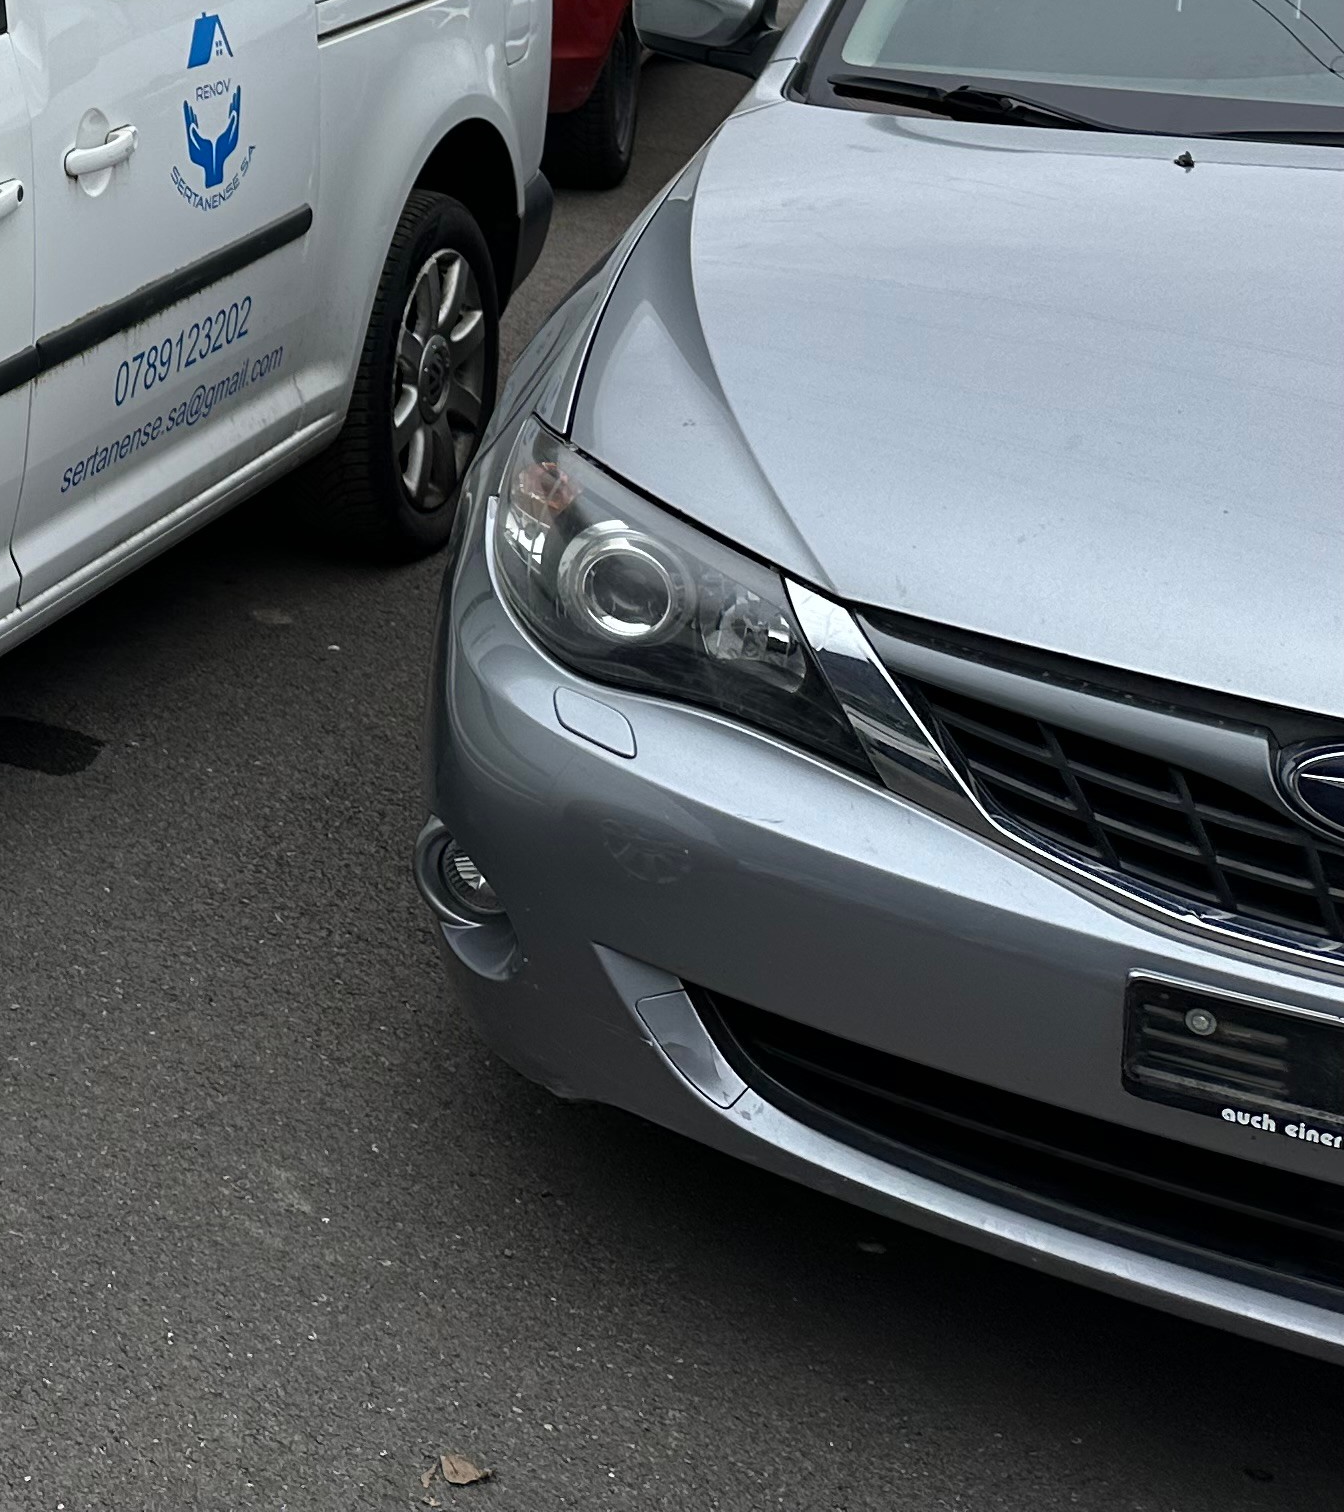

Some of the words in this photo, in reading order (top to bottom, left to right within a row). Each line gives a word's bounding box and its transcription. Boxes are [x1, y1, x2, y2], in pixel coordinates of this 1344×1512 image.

[195, 77, 232, 102] RENOV
[170, 165, 240, 212] SERTANENSE
[239, 145, 257, 178] SA
[114, 295, 252, 407] 0789123202
[60, 345, 284, 493] sertanense.sa@gmail.com
[1220, 1107, 1277, 1133] auch
[1284, 1122, 1343, 1149] einer
